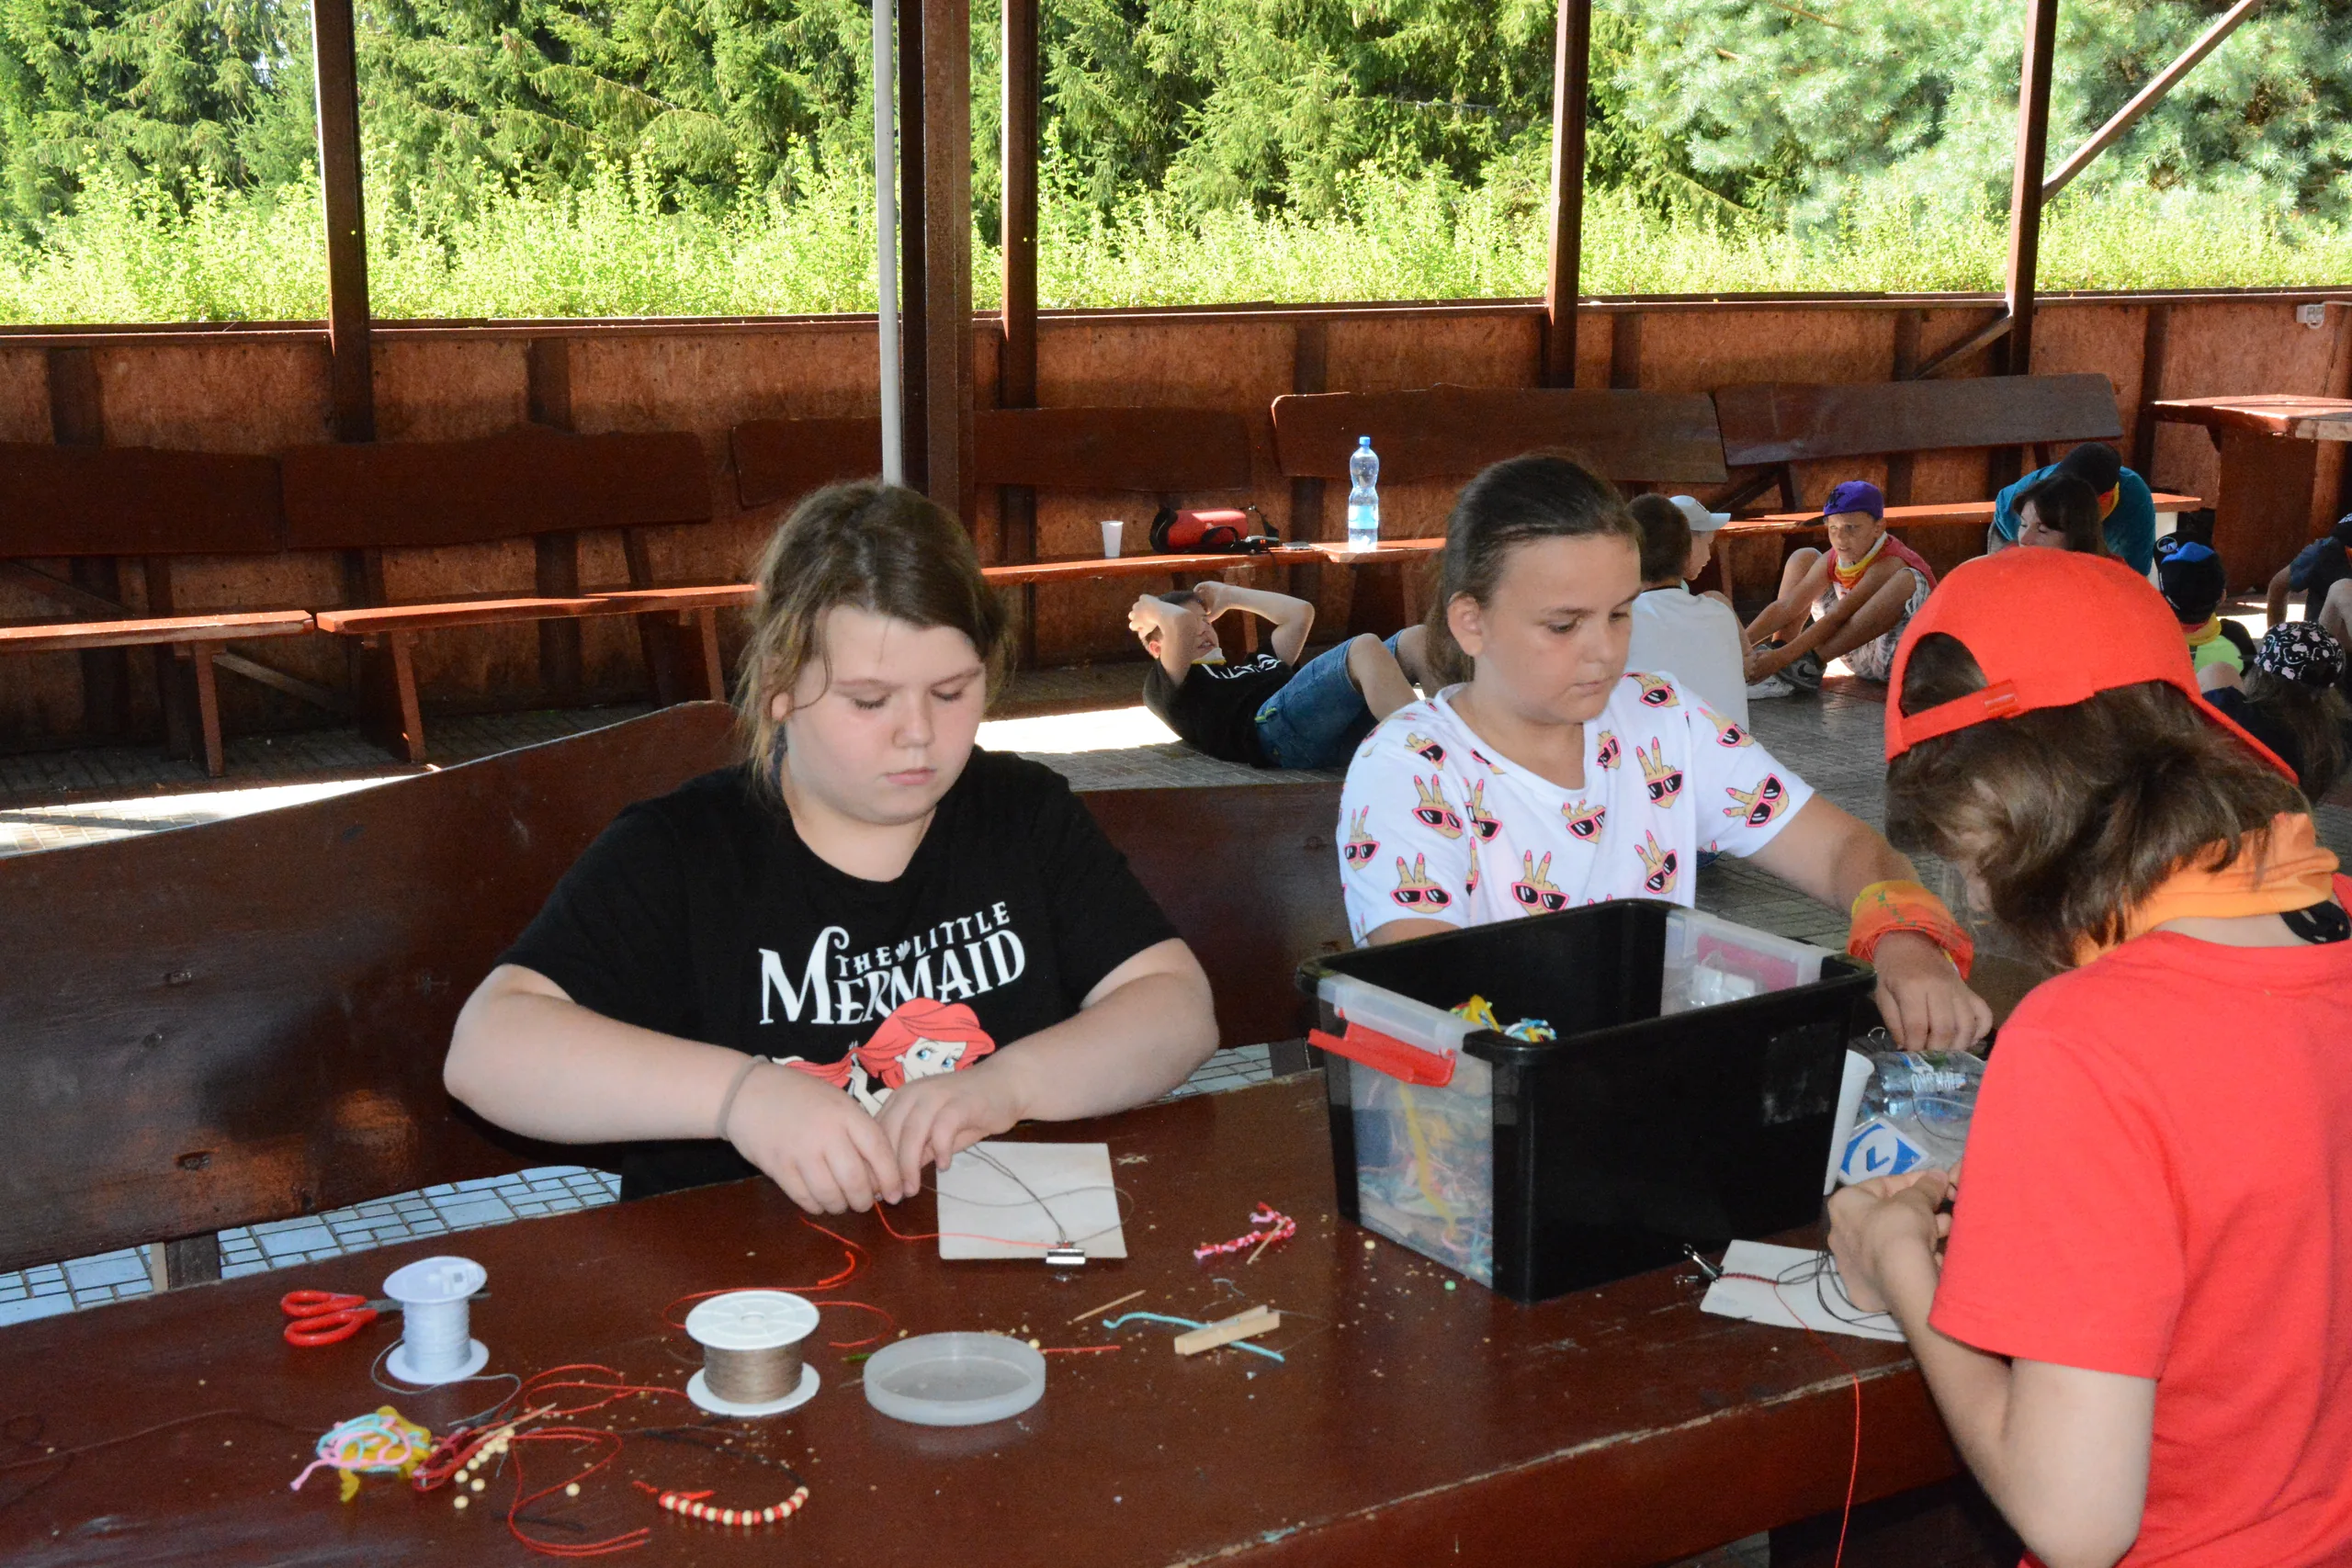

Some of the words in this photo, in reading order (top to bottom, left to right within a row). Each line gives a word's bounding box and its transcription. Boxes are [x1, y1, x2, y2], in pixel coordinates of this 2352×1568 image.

[758, 925, 1026, 1025] MERMAID
[834, 945, 893, 977] THE
[913, 900, 1012, 957] LITTLE
